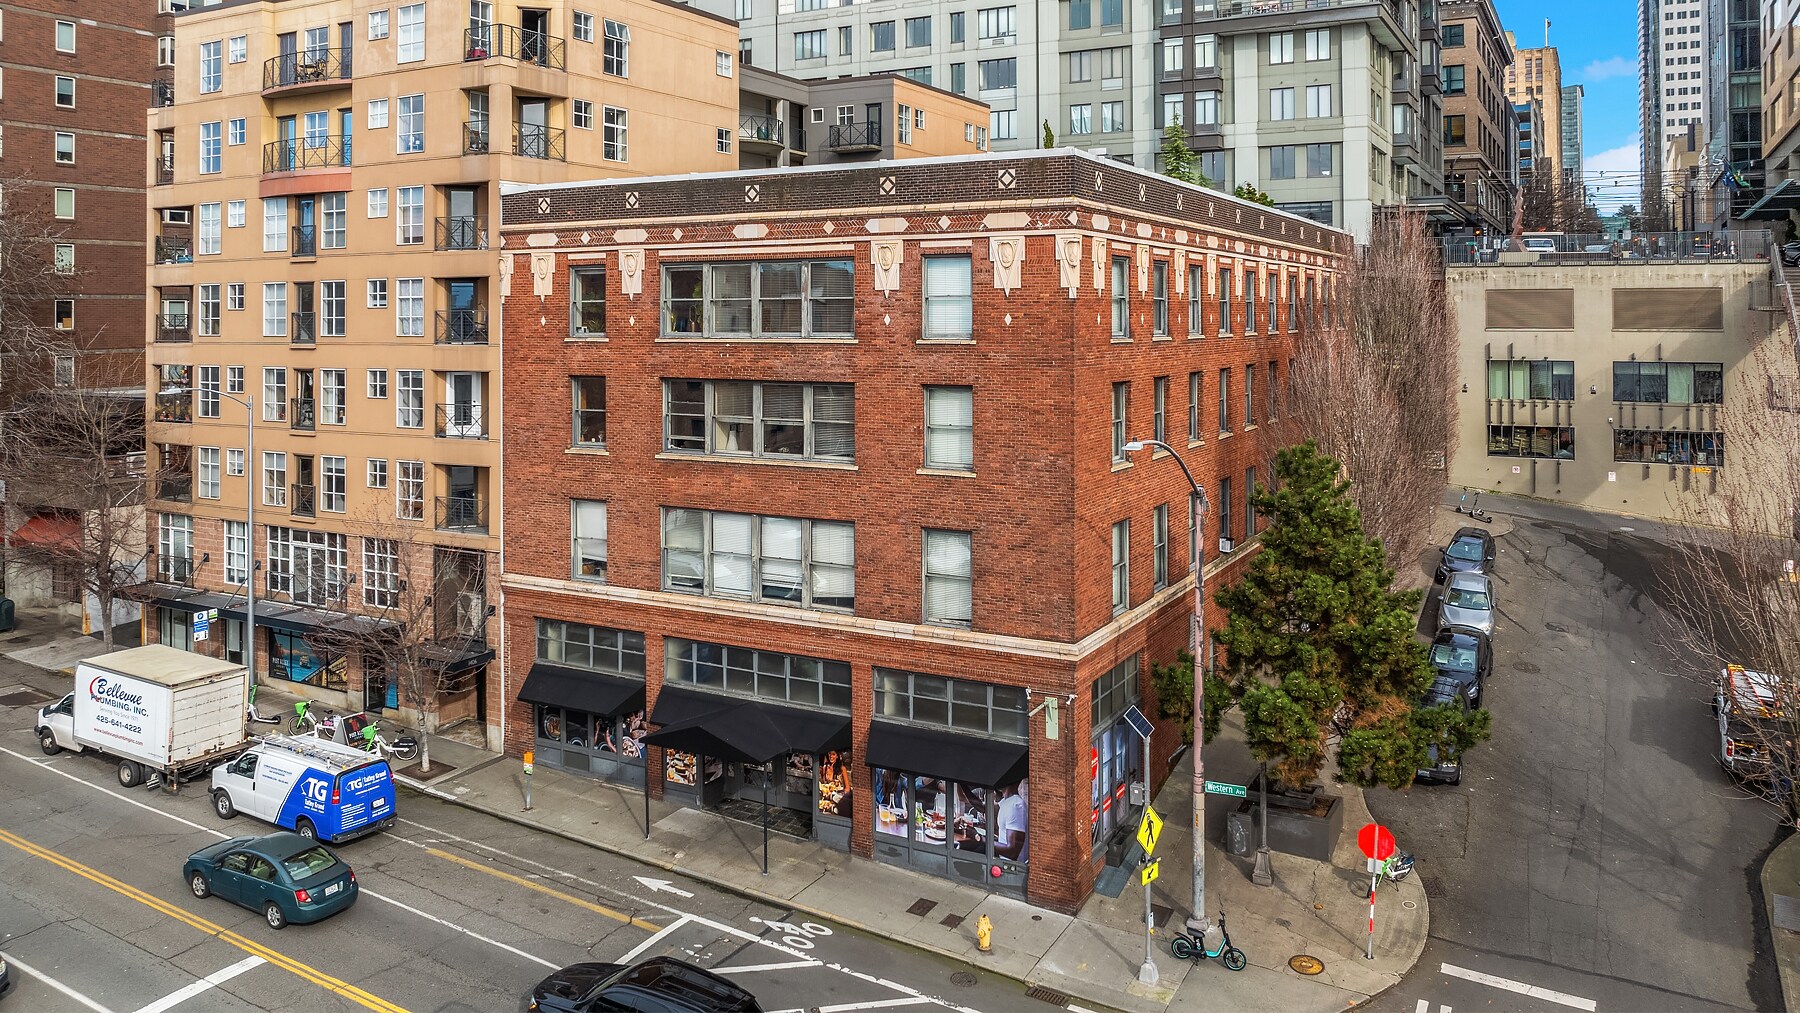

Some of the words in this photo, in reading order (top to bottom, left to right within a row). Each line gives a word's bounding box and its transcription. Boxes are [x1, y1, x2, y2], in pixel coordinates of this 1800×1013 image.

[97, 678, 143, 705] Bellevue
[133, 706, 149, 717] INC.
[96, 714, 142, 734] 425-641-4222
[307, 777, 329, 801] TG
[349, 778, 363, 791] TG
[1207, 782, 1233, 794] Western
